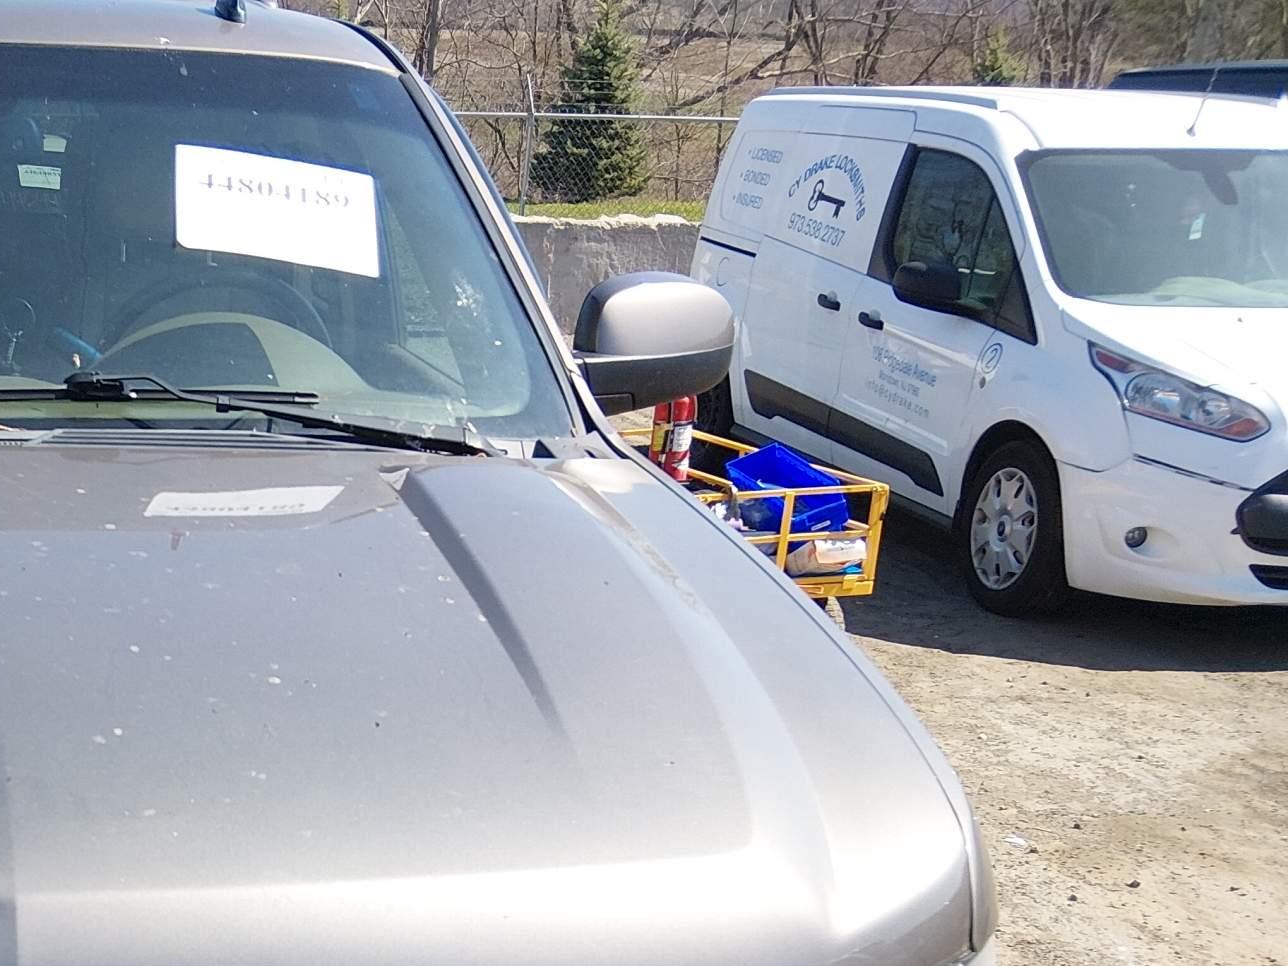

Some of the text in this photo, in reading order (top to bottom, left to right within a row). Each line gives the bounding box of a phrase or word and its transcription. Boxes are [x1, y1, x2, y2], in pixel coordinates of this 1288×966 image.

[199, 172, 349, 209] 44804189
[788, 154, 866, 221] CY DRAKE LOCKSMITHS
